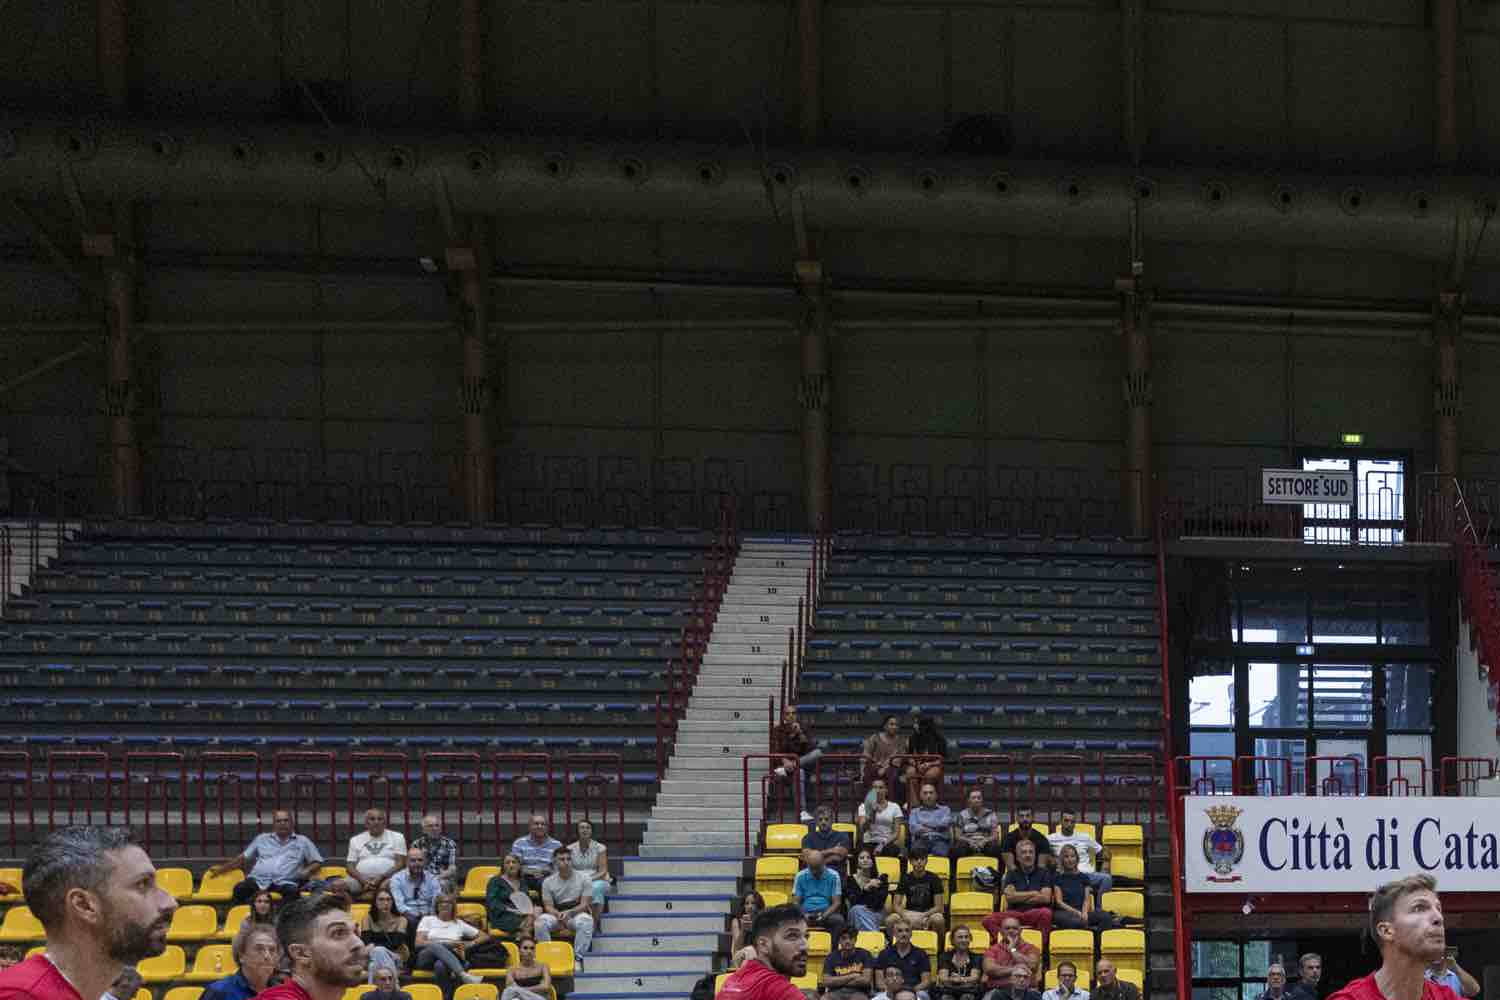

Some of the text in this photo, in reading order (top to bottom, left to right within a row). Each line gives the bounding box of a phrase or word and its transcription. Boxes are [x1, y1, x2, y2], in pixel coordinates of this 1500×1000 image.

[1268, 477, 1348, 497] SETTORE SUD
[1258, 816, 1353, 871] Città
[1365, 817, 1400, 871] di
